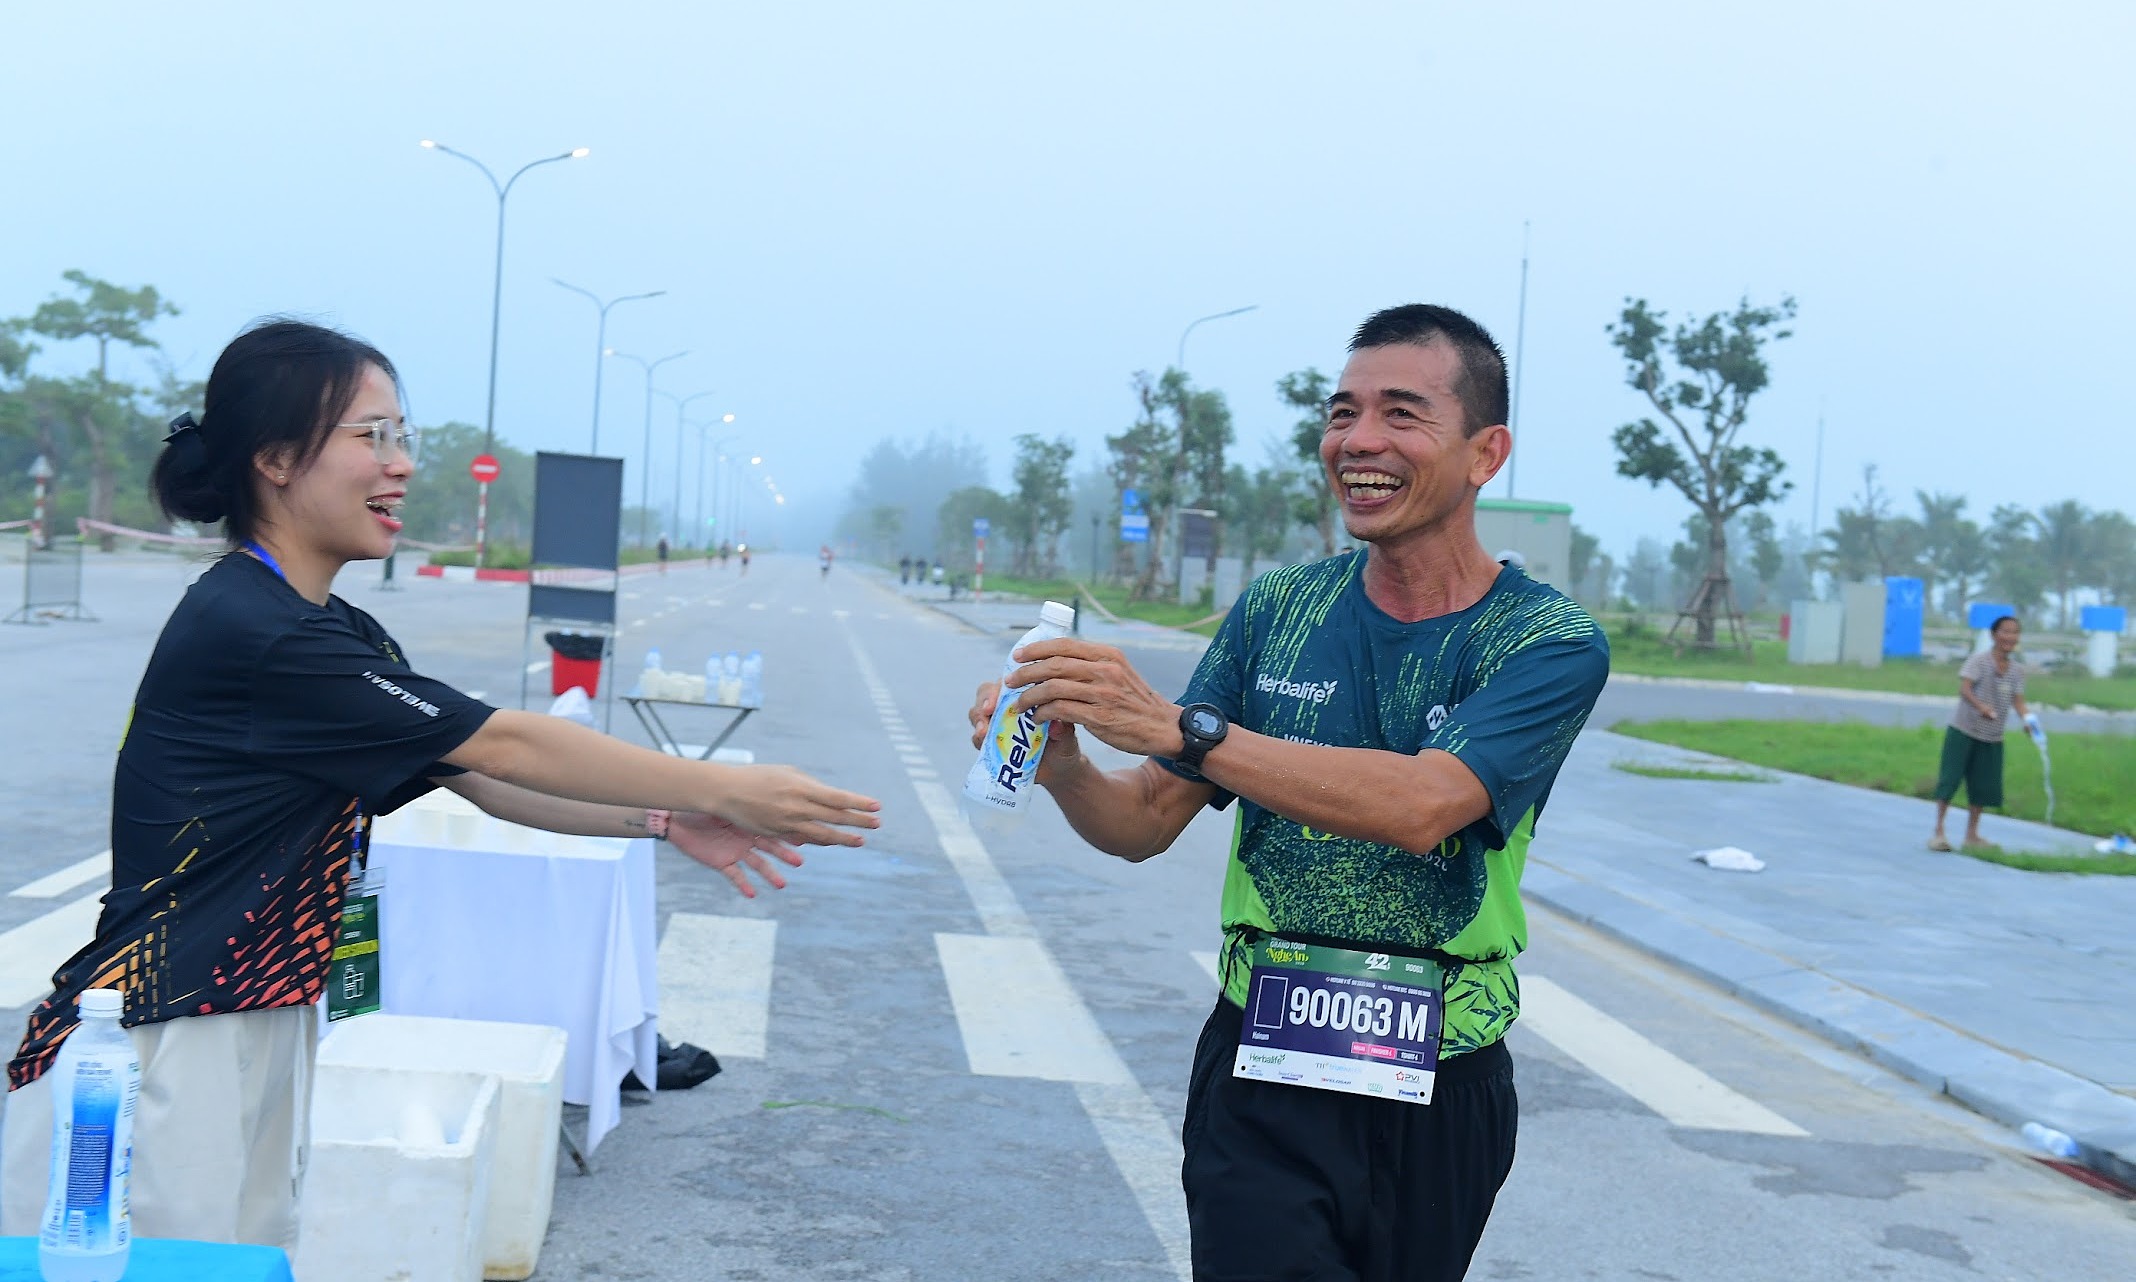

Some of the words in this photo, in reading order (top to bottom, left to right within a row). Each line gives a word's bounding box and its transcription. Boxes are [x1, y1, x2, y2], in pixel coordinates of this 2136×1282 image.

[1255, 673, 1327, 703] Herbalife
[1291, 942, 1307, 950] TOUR
[1289, 986, 1394, 1037] 90063
[1397, 1001, 1428, 1042] M
[1249, 1053, 1283, 1065] Herbalife
